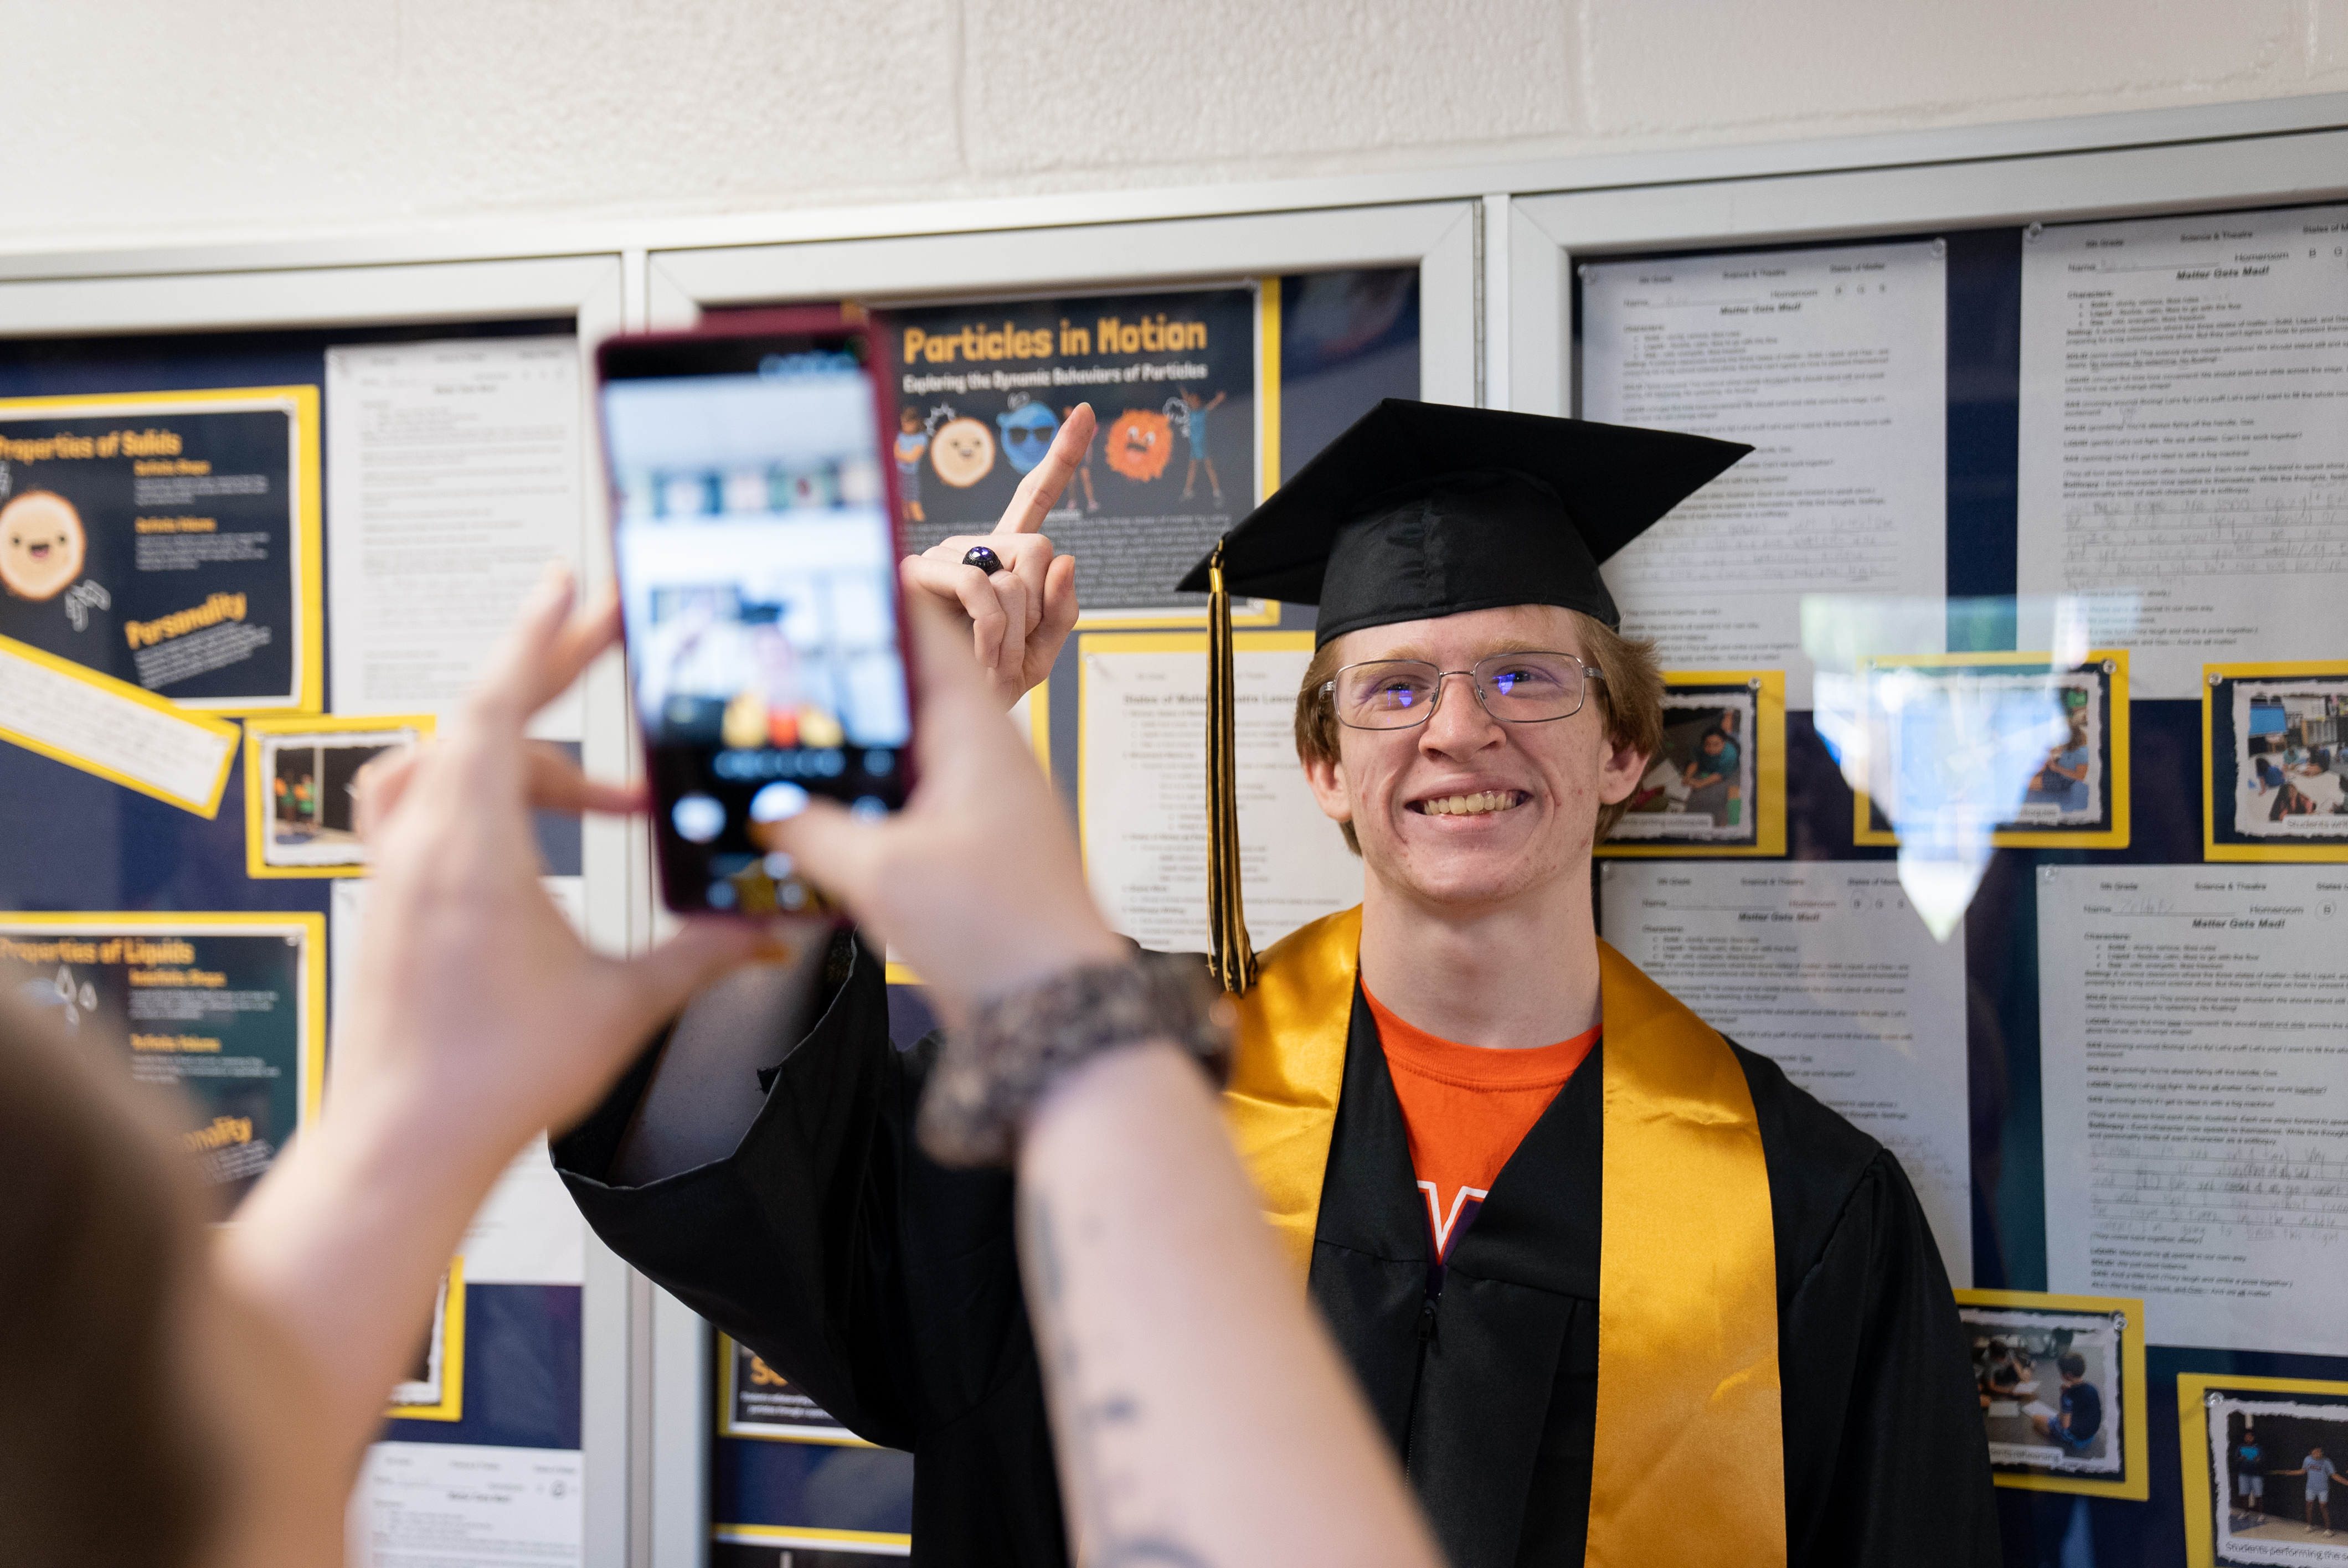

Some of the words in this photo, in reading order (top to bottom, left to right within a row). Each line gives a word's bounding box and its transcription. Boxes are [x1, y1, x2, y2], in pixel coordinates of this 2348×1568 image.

[2177, 268, 2210, 281] Matter
[2213, 266, 2239, 279] Gets
[2243, 265, 2269, 277] Mad!
[903, 321, 1053, 364] Particles
[1059, 318, 1090, 357] in
[1097, 313, 1208, 355] Motion
[903, 372, 967, 395] Exploring
[967, 370, 992, 389] the
[992, 368, 1051, 391] Dynamic
[1052, 365, 1122, 386] Behaviors
[1123, 364, 1141, 383] of
[1141, 360, 1209, 381] Particles
[96, 430, 119, 458] of
[121, 429, 183, 457] Solids
[123, 591, 247, 650] Personality
[2192, 918, 2226, 930] Matter
[2229, 919, 2256, 930] Gets
[2258, 919, 2286, 930] Mad!
[99, 936, 122, 964] of
[123, 936, 195, 968] Liquids
[2225, 1541, 2268, 1555] Students
[2270, 1545, 2323, 1561] performing
[2324, 1550, 2340, 1561] the
